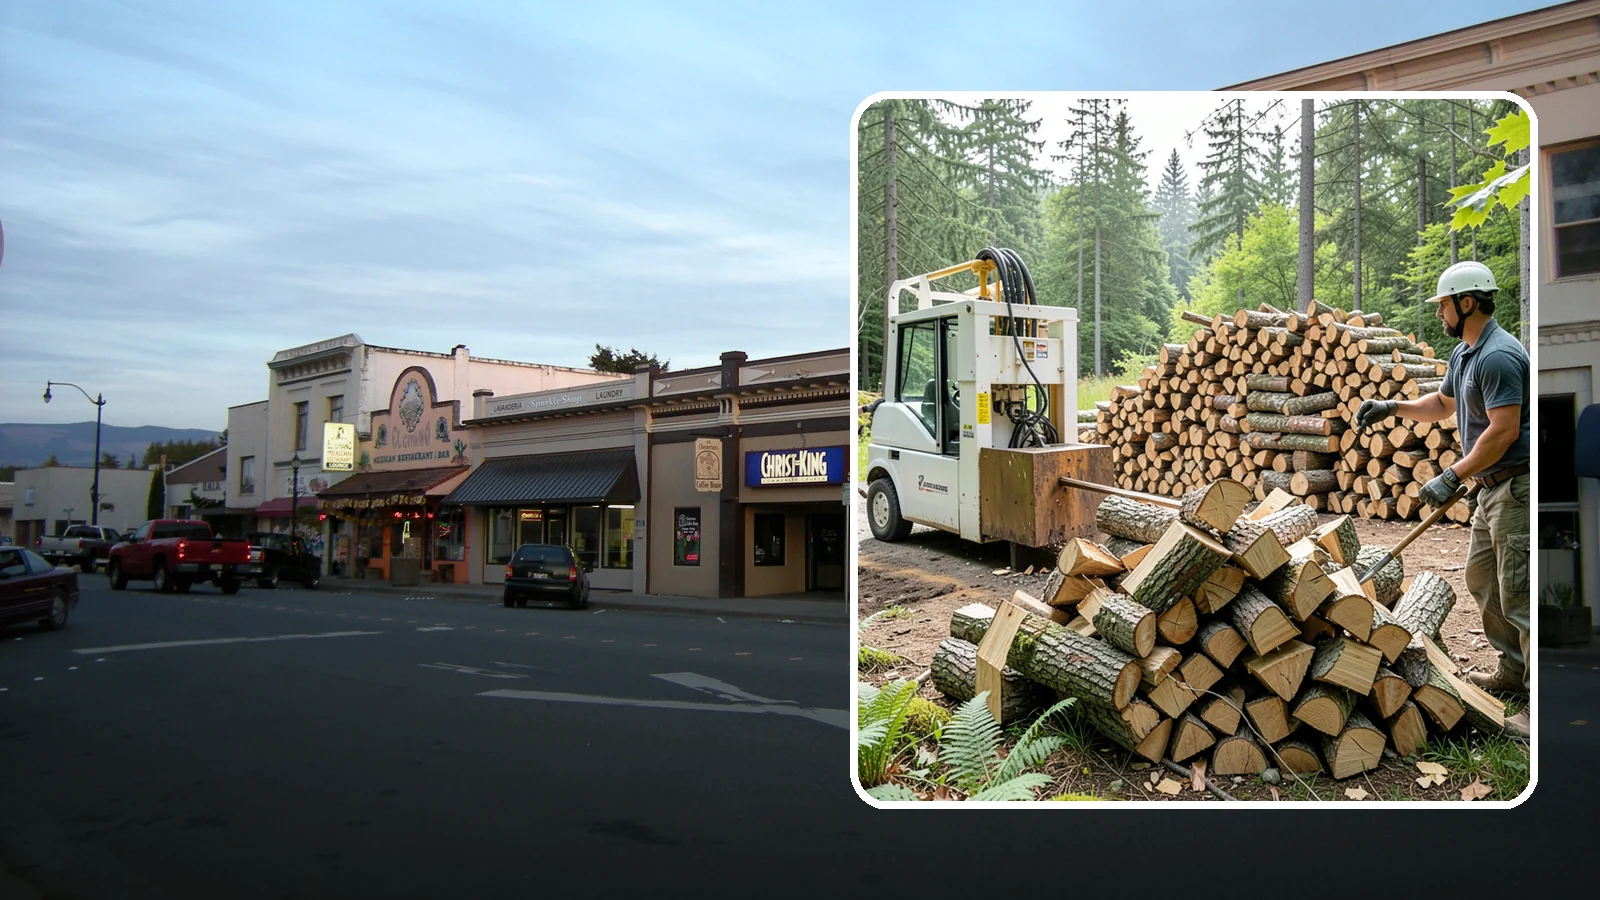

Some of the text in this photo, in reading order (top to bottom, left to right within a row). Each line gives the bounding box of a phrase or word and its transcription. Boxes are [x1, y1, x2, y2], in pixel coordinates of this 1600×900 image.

[531, 393, 582, 408] Sparkle Shop
[595, 389, 624, 400] LAUNDRY
[493, 402, 522, 413] LAVANDERIA
[374, 450, 450, 464] MEXICAN RESTAURANT BAR
